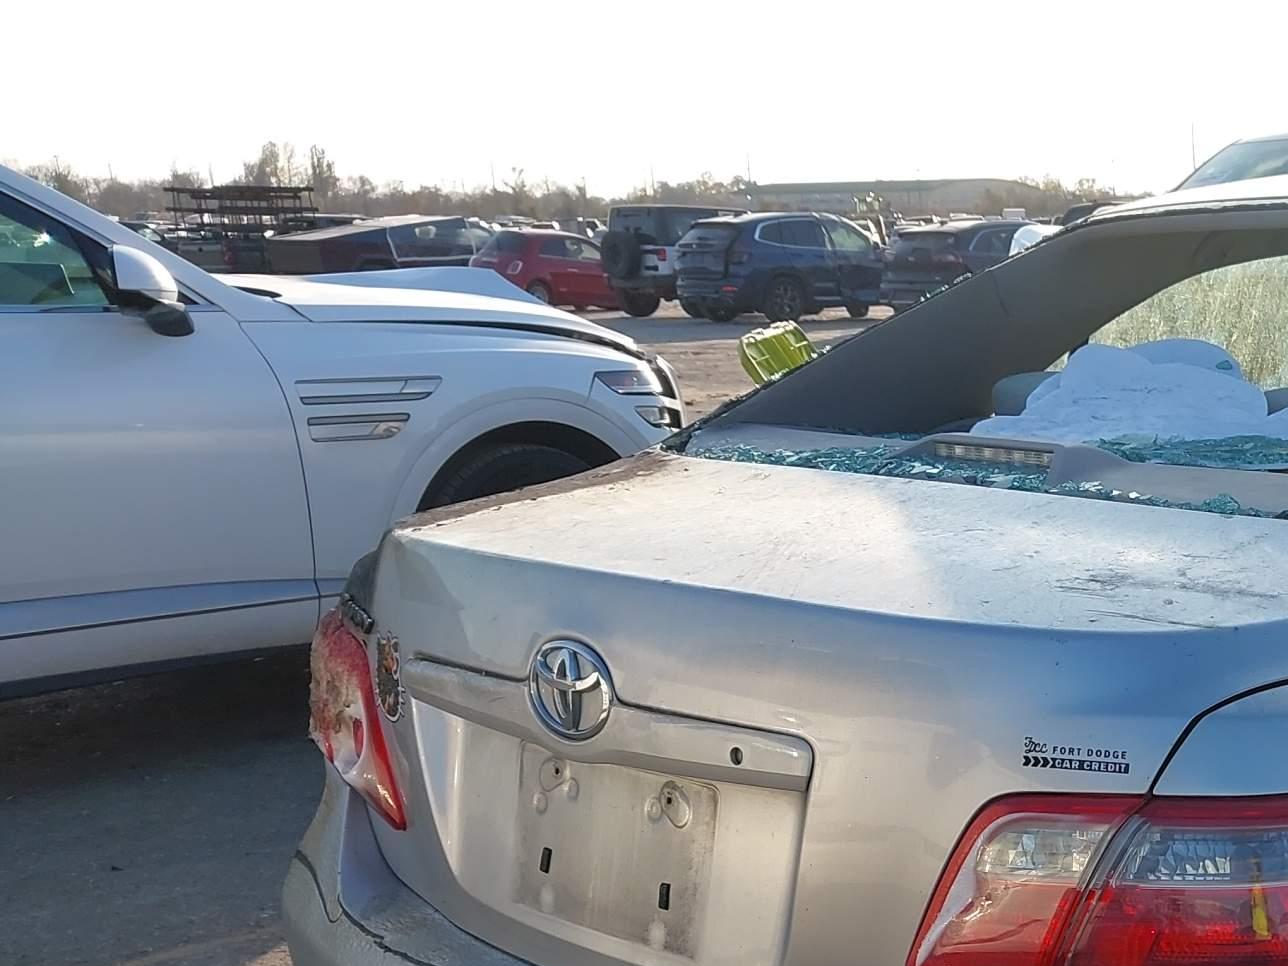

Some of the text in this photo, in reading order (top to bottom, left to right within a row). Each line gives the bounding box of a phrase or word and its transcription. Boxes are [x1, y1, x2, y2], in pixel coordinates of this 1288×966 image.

[1052, 745, 1127, 760] FORT DODGE
[1055, 758, 1127, 773] CAR CREDIT
